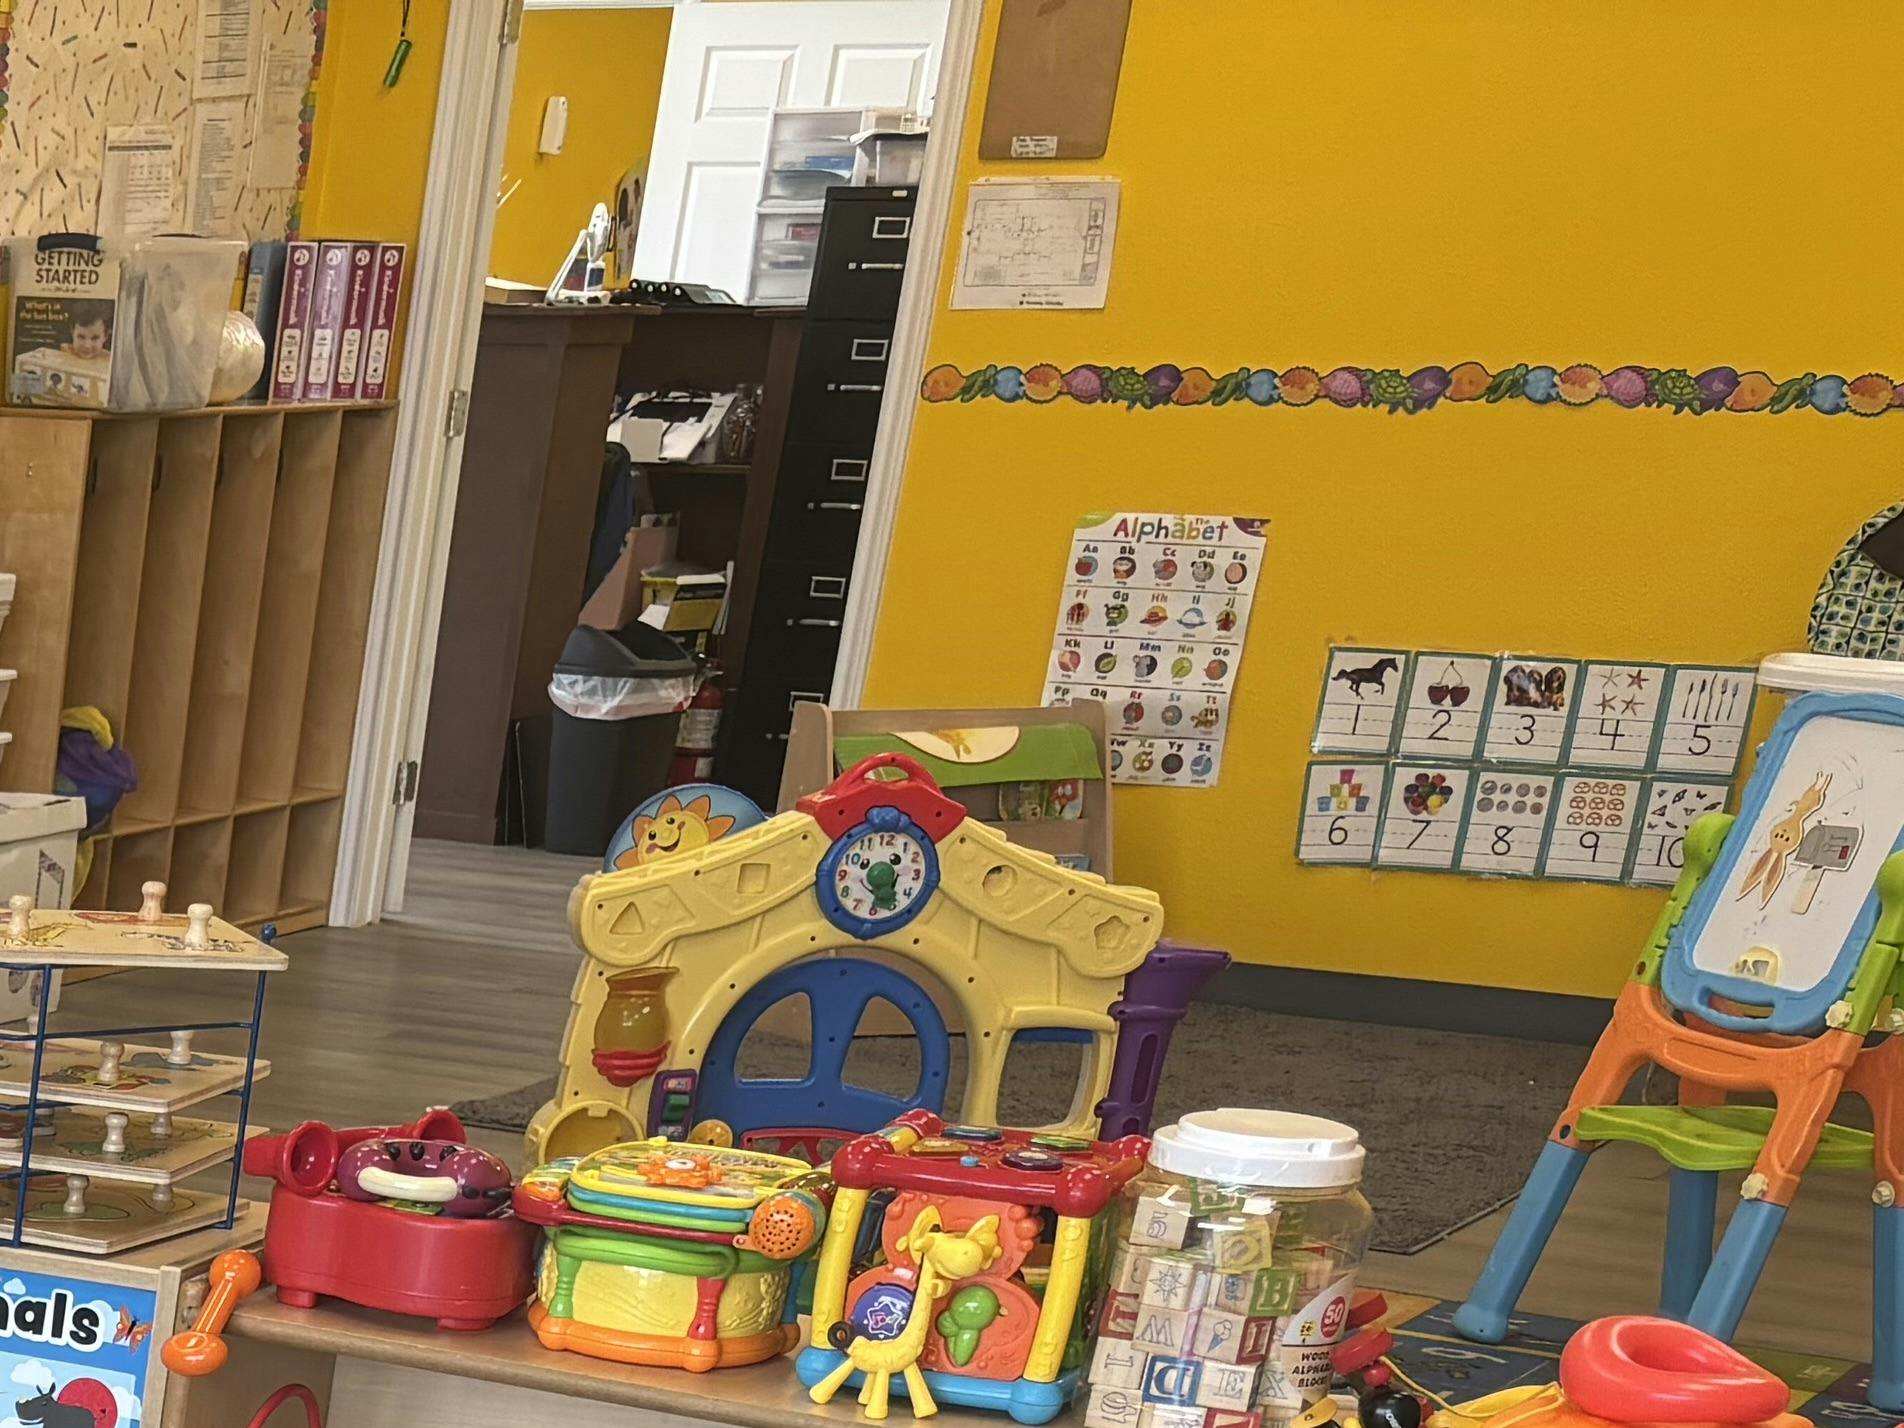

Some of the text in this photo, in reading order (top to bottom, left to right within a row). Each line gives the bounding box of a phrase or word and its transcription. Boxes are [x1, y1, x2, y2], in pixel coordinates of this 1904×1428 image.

[35, 268, 99, 285] STARTED
[1113, 518, 1228, 543] Alphabet
[1351, 704, 1712, 755] 1 2 3 4 5
[1328, 816, 1348, 845] 6
[1406, 820, 1432, 848] 7
[1491, 826, 1511, 855] 8
[1579, 831, 1599, 862] 9
[838, 834, 921, 910] 12 1 2 3 4 7 8 9 10 11
[1325, 1305, 1344, 1325] 50
[1213, 1368, 1246, 1399] E
